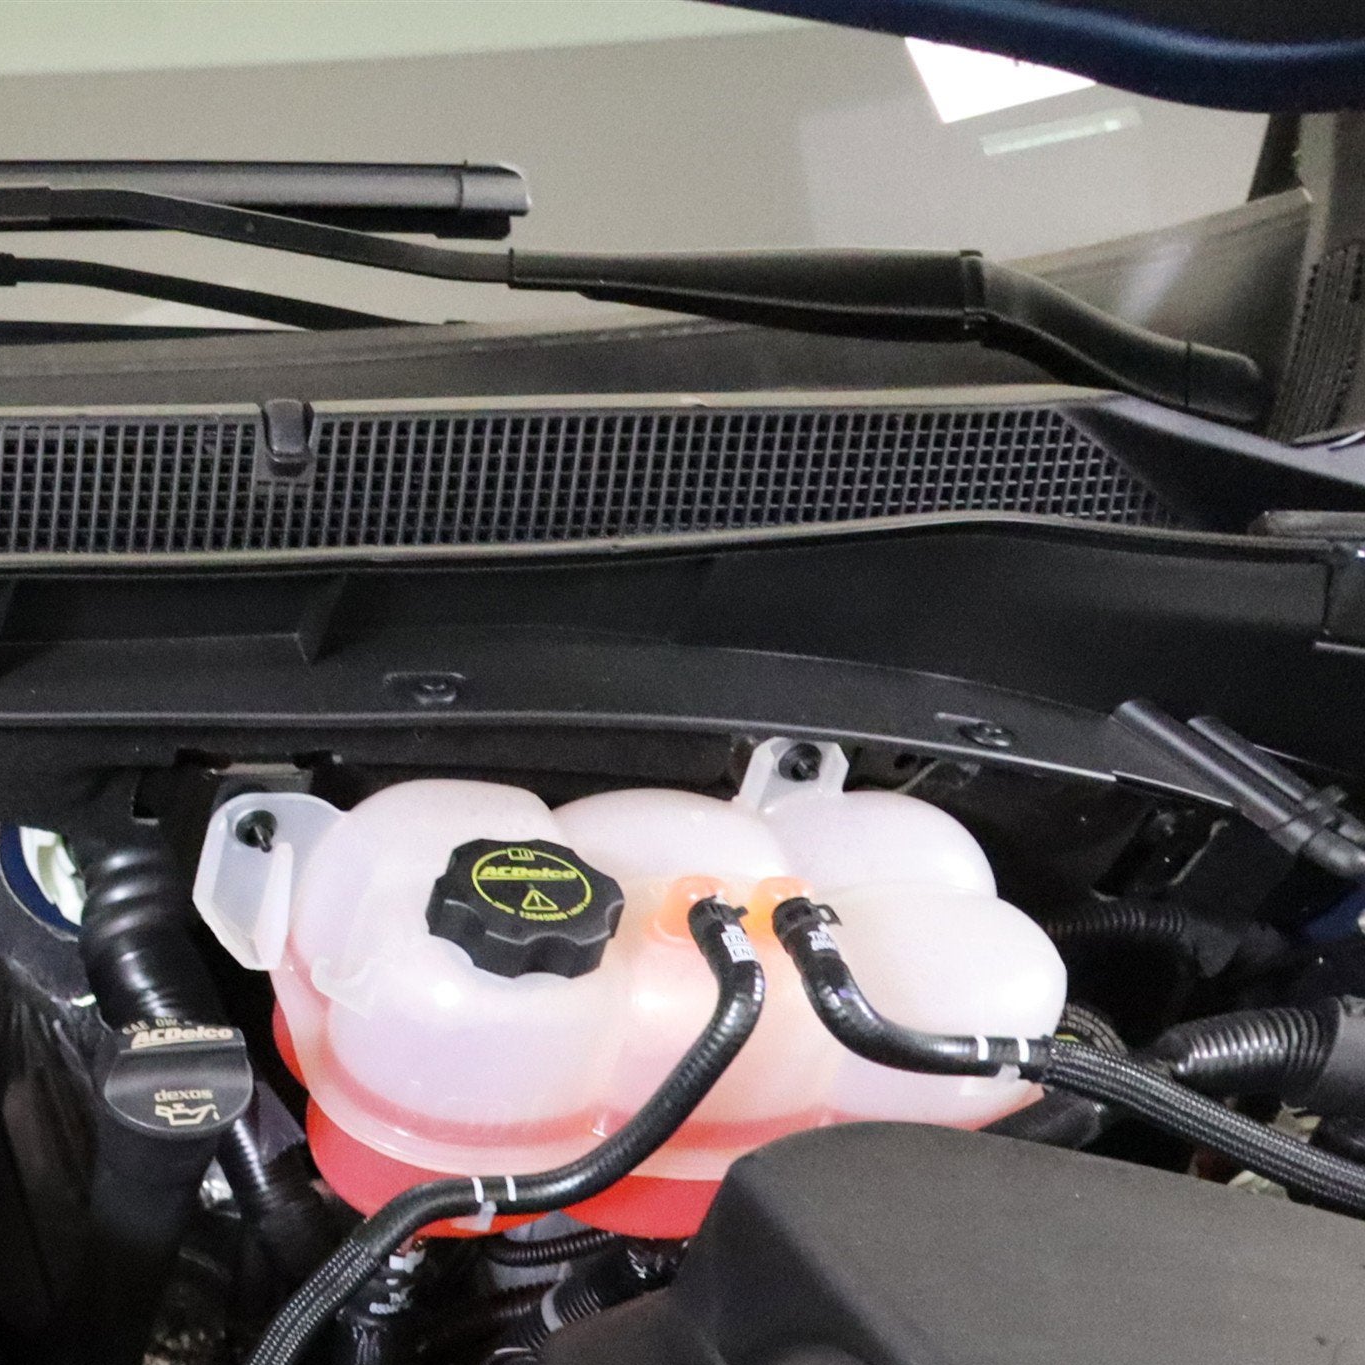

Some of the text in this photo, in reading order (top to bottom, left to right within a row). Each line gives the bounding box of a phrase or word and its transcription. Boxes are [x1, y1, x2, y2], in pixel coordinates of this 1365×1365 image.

[479, 866, 577, 880] ACDelco
[131, 1026, 235, 1047] ACDelco
[154, 1089, 214, 1103] dexos
